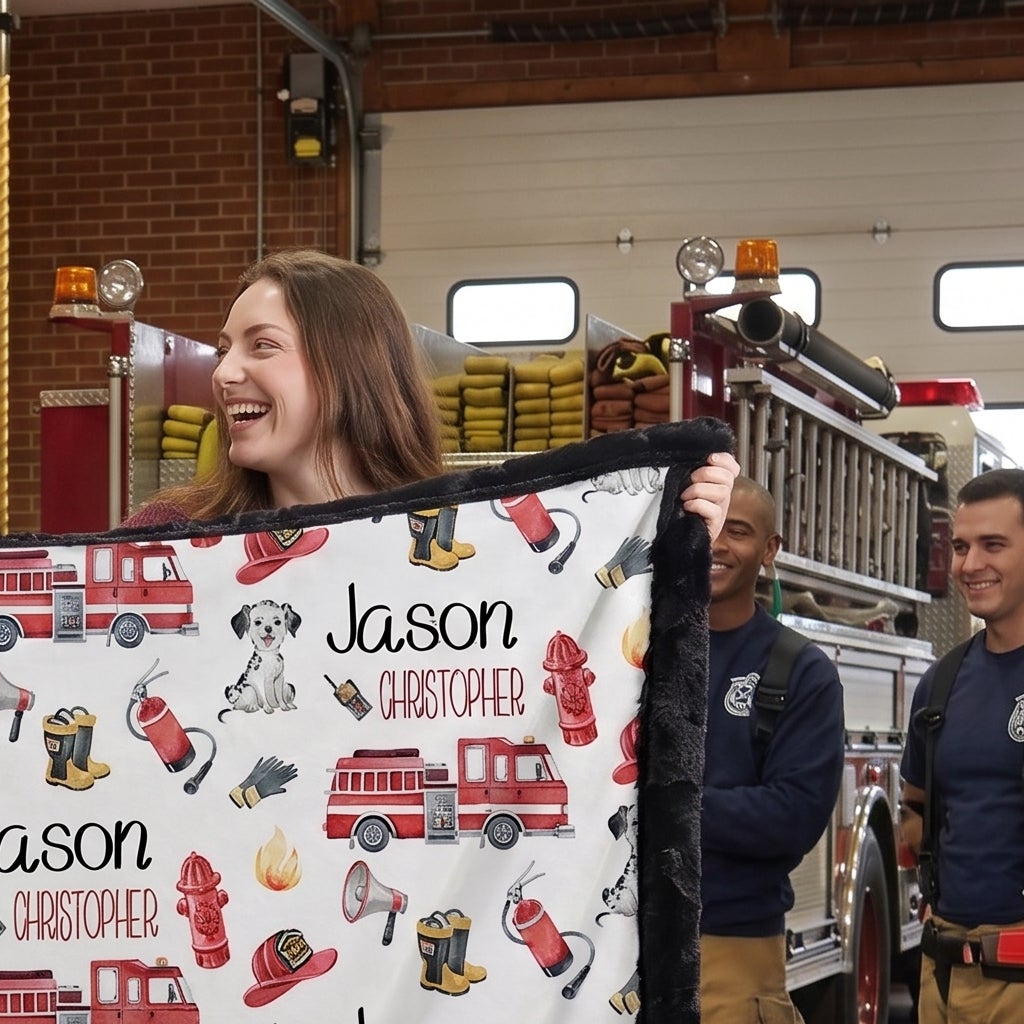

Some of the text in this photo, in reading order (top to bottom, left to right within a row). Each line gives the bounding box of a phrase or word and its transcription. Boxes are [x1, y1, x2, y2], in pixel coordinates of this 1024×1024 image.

[327, 583, 517, 653] Jason
[380, 668, 524, 719] CHRISTOPHER
[15, 889, 158, 941] CHRISTOPHER
